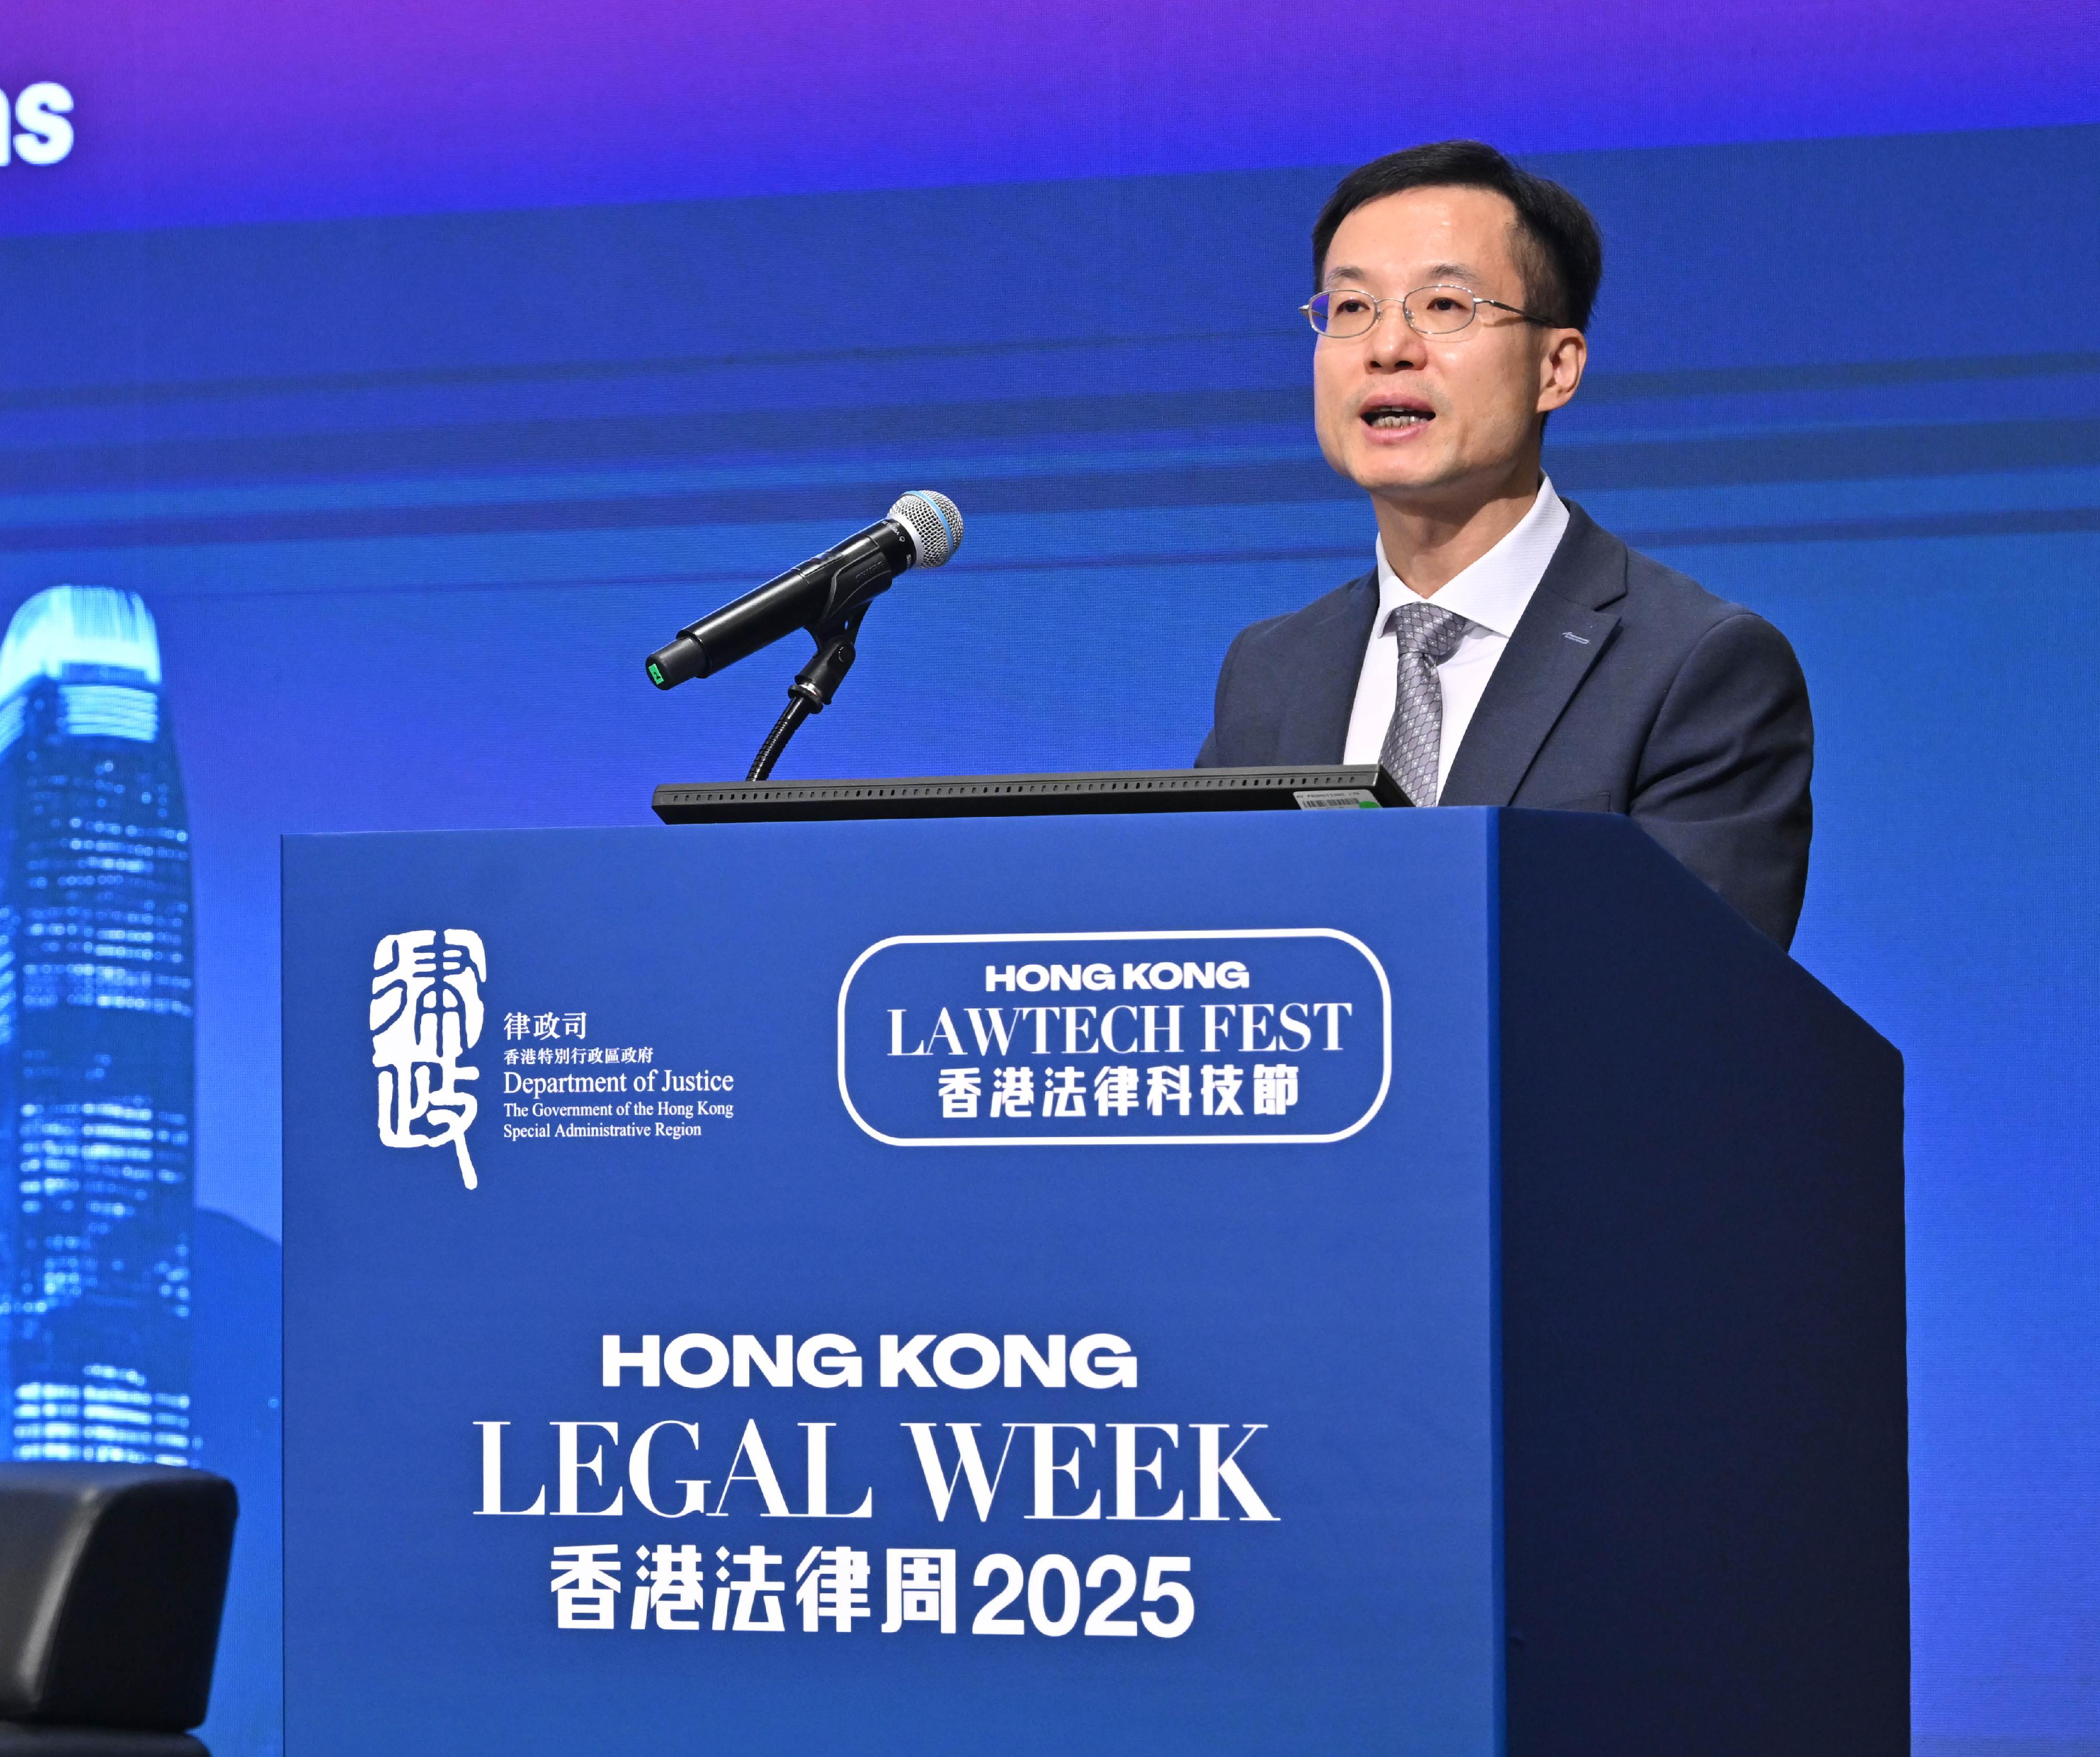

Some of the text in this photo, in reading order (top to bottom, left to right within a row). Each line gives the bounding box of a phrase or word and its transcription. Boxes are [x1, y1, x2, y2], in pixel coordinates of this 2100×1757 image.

[0, 81, 74, 166] s
[986, 961, 1249, 992] HONG KONG
[504, 1012, 586, 1040] 律政司
[887, 1003, 1352, 1056] LAWTECH FEST
[504, 1047, 653, 1065] 香港特別行政區政府
[504, 1069, 733, 1099] Department of Justice
[939, 1064, 1298, 1118] 香港法律科技節
[504, 1101, 733, 1119] The Government of the Hong Kong
[504, 1122, 701, 1142] Special Administrative Region
[603, 1333, 1137, 1389] HONG KONG
[473, 1419, 1280, 1522] LEGAL WEEK
